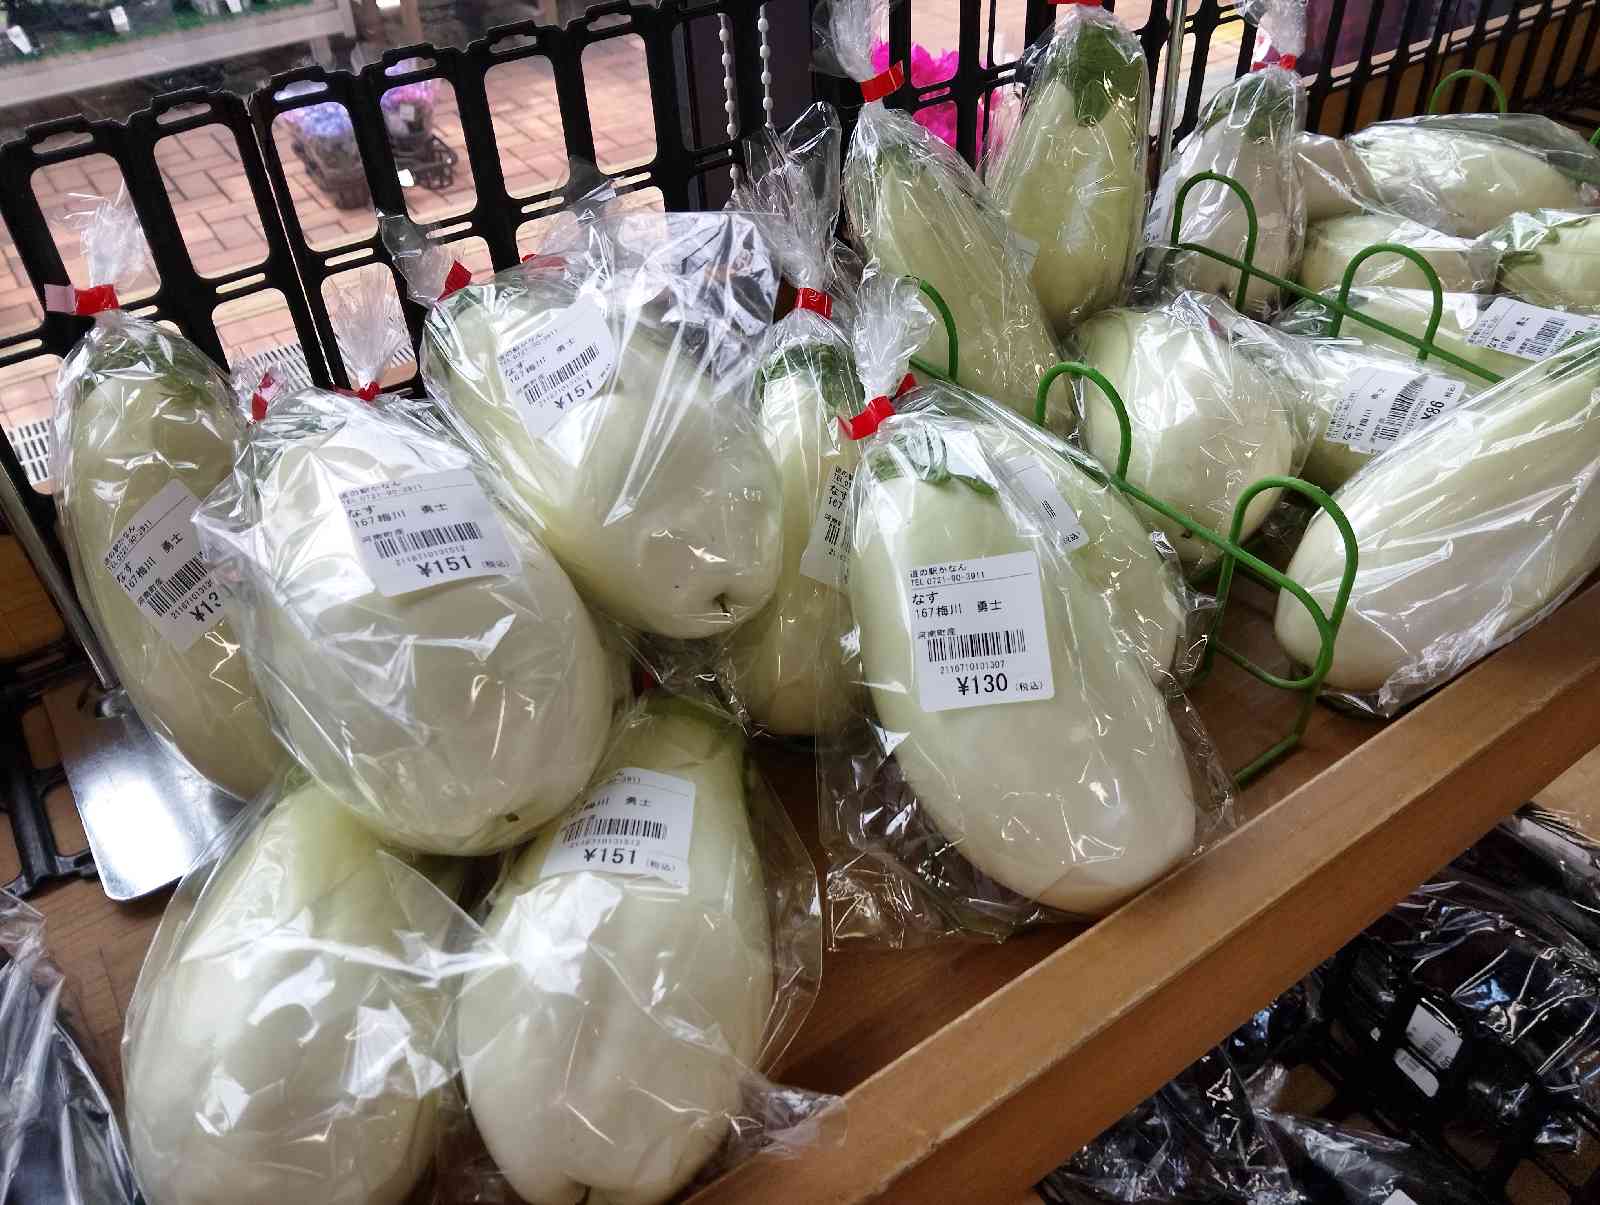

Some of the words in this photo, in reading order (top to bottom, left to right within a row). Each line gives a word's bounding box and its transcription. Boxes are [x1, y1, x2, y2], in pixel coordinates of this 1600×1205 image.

[554, 379, 592, 410] ¥151
[416, 555, 472, 578] ¥151
[910, 563, 967, 578] 道の駅かなん
[911, 578, 925, 586] TEL
[912, 591, 939, 605] なす
[916, 603, 962, 619] 167梅川
[956, 672, 1008, 695] ¥130
[583, 847, 636, 865] ¥151
